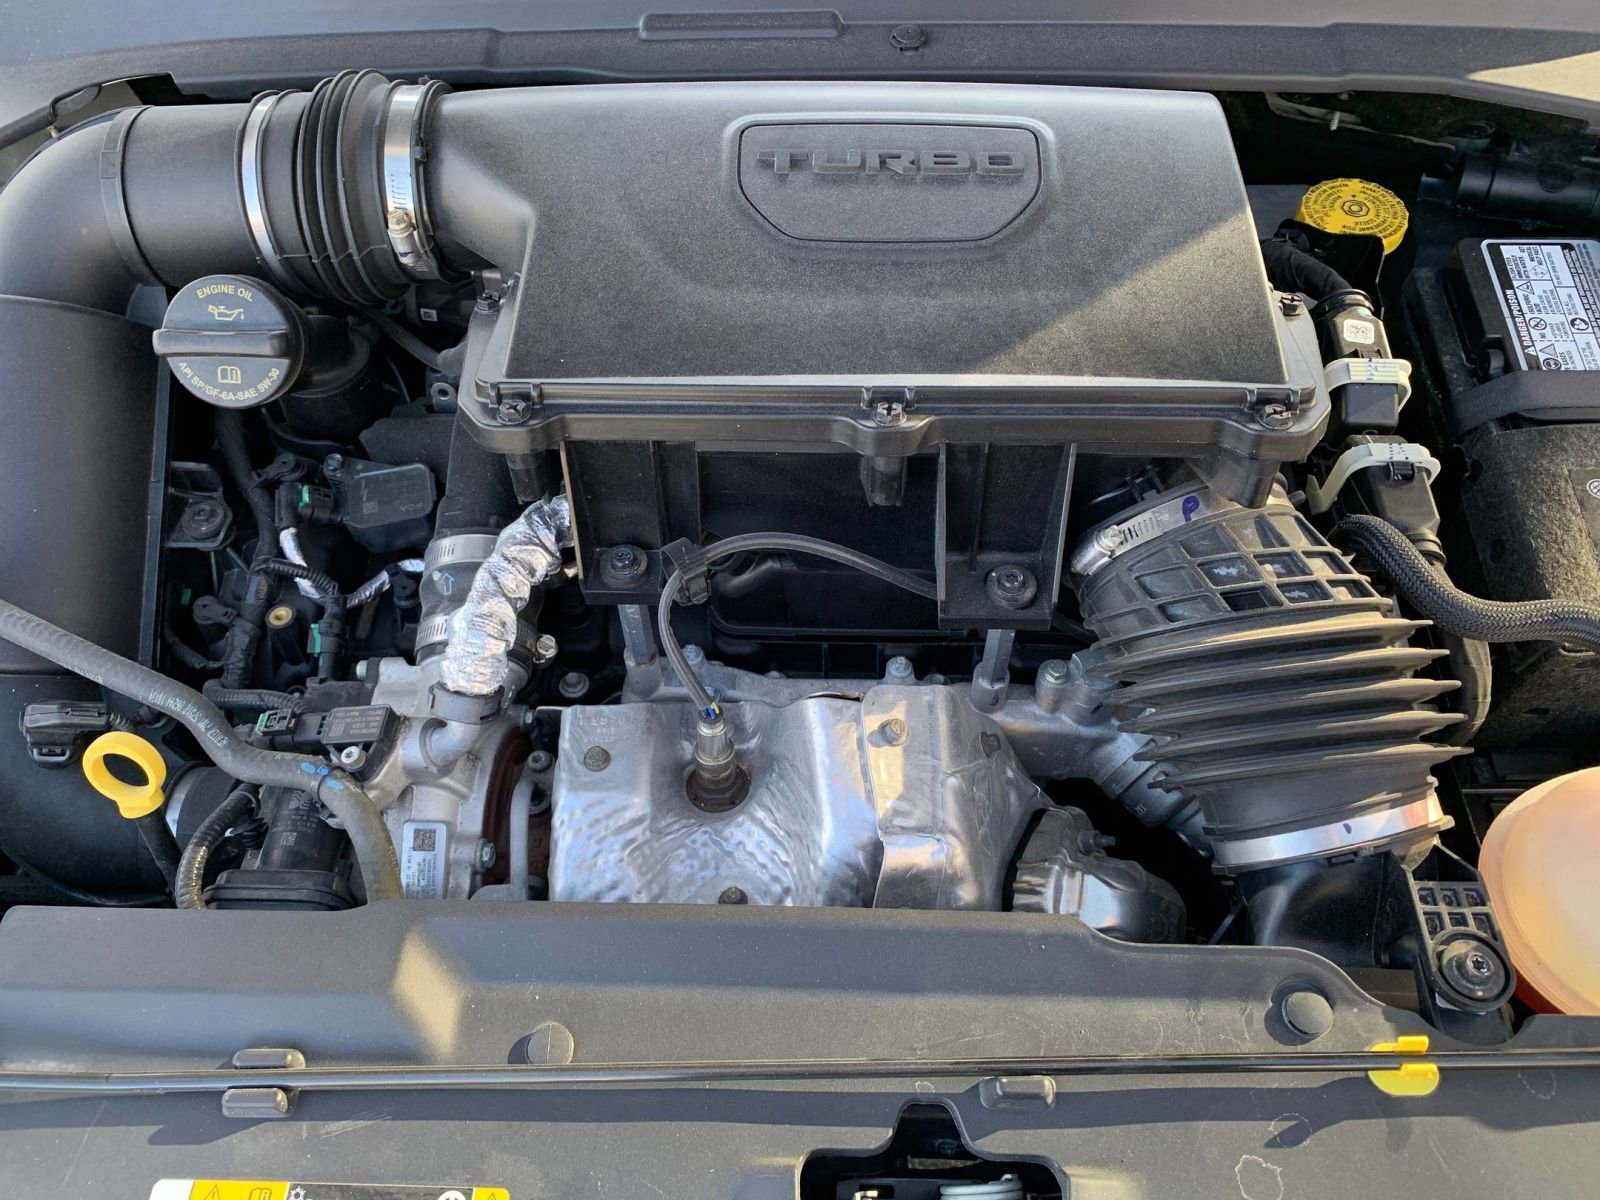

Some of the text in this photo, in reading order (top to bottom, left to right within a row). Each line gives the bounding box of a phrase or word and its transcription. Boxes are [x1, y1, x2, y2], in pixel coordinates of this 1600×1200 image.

[756, 150, 1025, 175] TURBO
[196, 284, 254, 302] ENGINE OIL
[1506, 290, 1532, 346] DANGER/POISON
[1558, 352, 1569, 365] GASES
[178, 362, 192, 378] API
[257, 368, 280, 393] 5W-30
